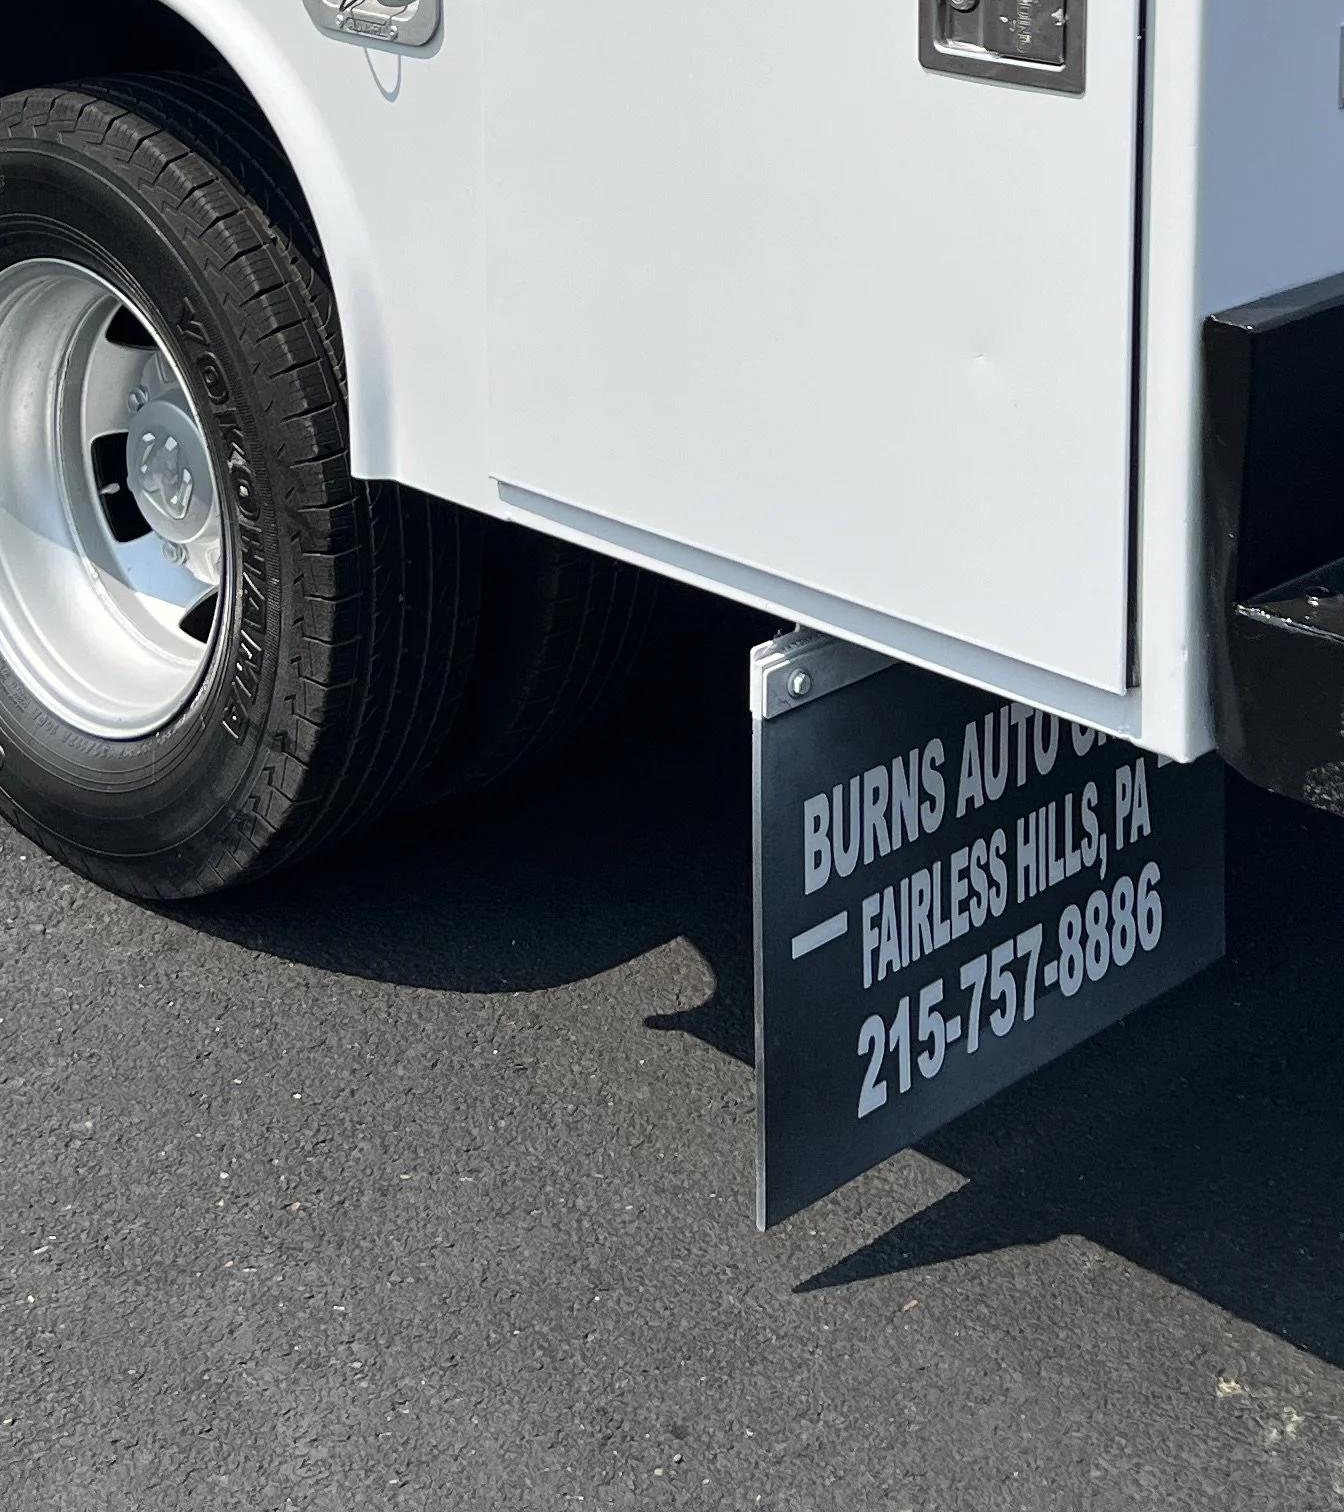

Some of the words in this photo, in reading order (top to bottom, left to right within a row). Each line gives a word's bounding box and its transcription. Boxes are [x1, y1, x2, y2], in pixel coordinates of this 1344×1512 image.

[176, 296, 267, 744] YOKOHAMA
[803, 737, 946, 896] BURNS
[955, 701, 1060, 819] AUTO
[862, 828, 1008, 989] FAIRLESS
[1016, 781, 1107, 904] HILLS,
[1115, 756, 1152, 851] PA
[857, 861, 1163, 1120] 215-757-8886
